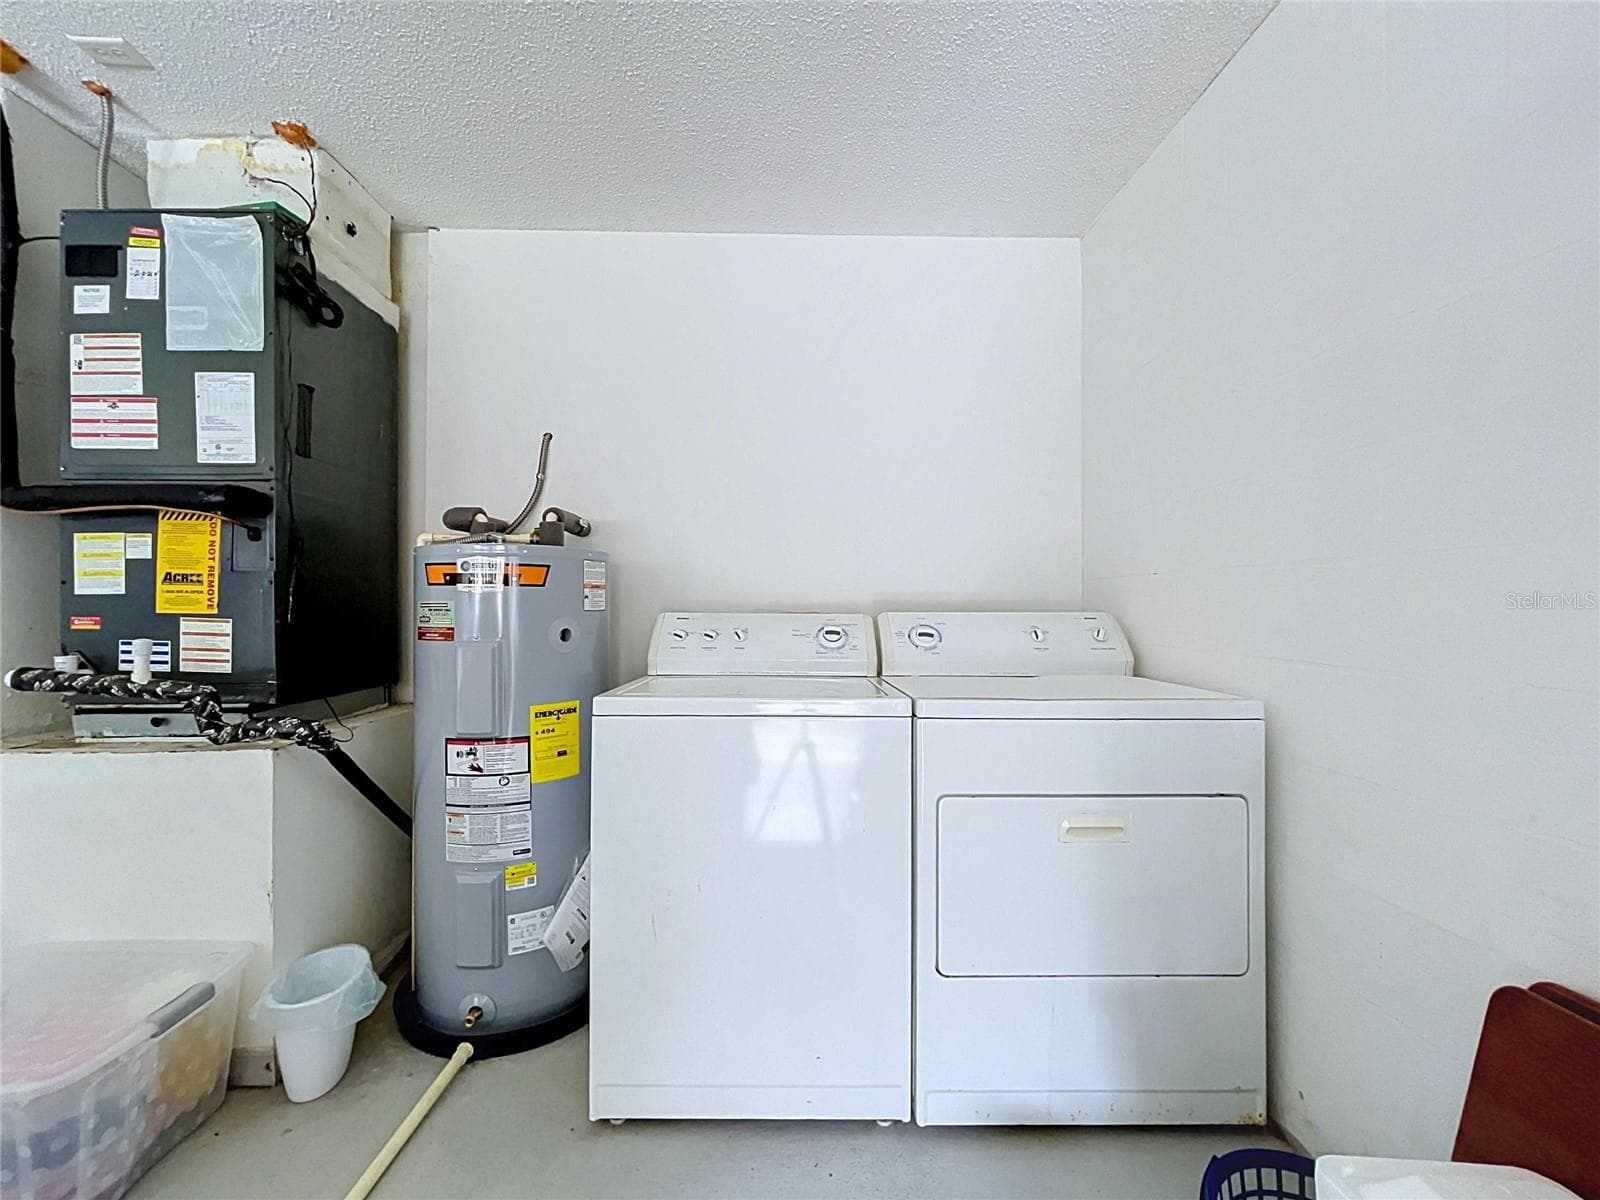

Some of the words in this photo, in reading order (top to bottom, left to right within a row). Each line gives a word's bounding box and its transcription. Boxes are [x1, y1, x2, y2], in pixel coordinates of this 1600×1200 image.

[209, 521, 217, 537] DO
[208, 540, 216, 563] NOT
[207, 565, 215, 610] REMOVE
